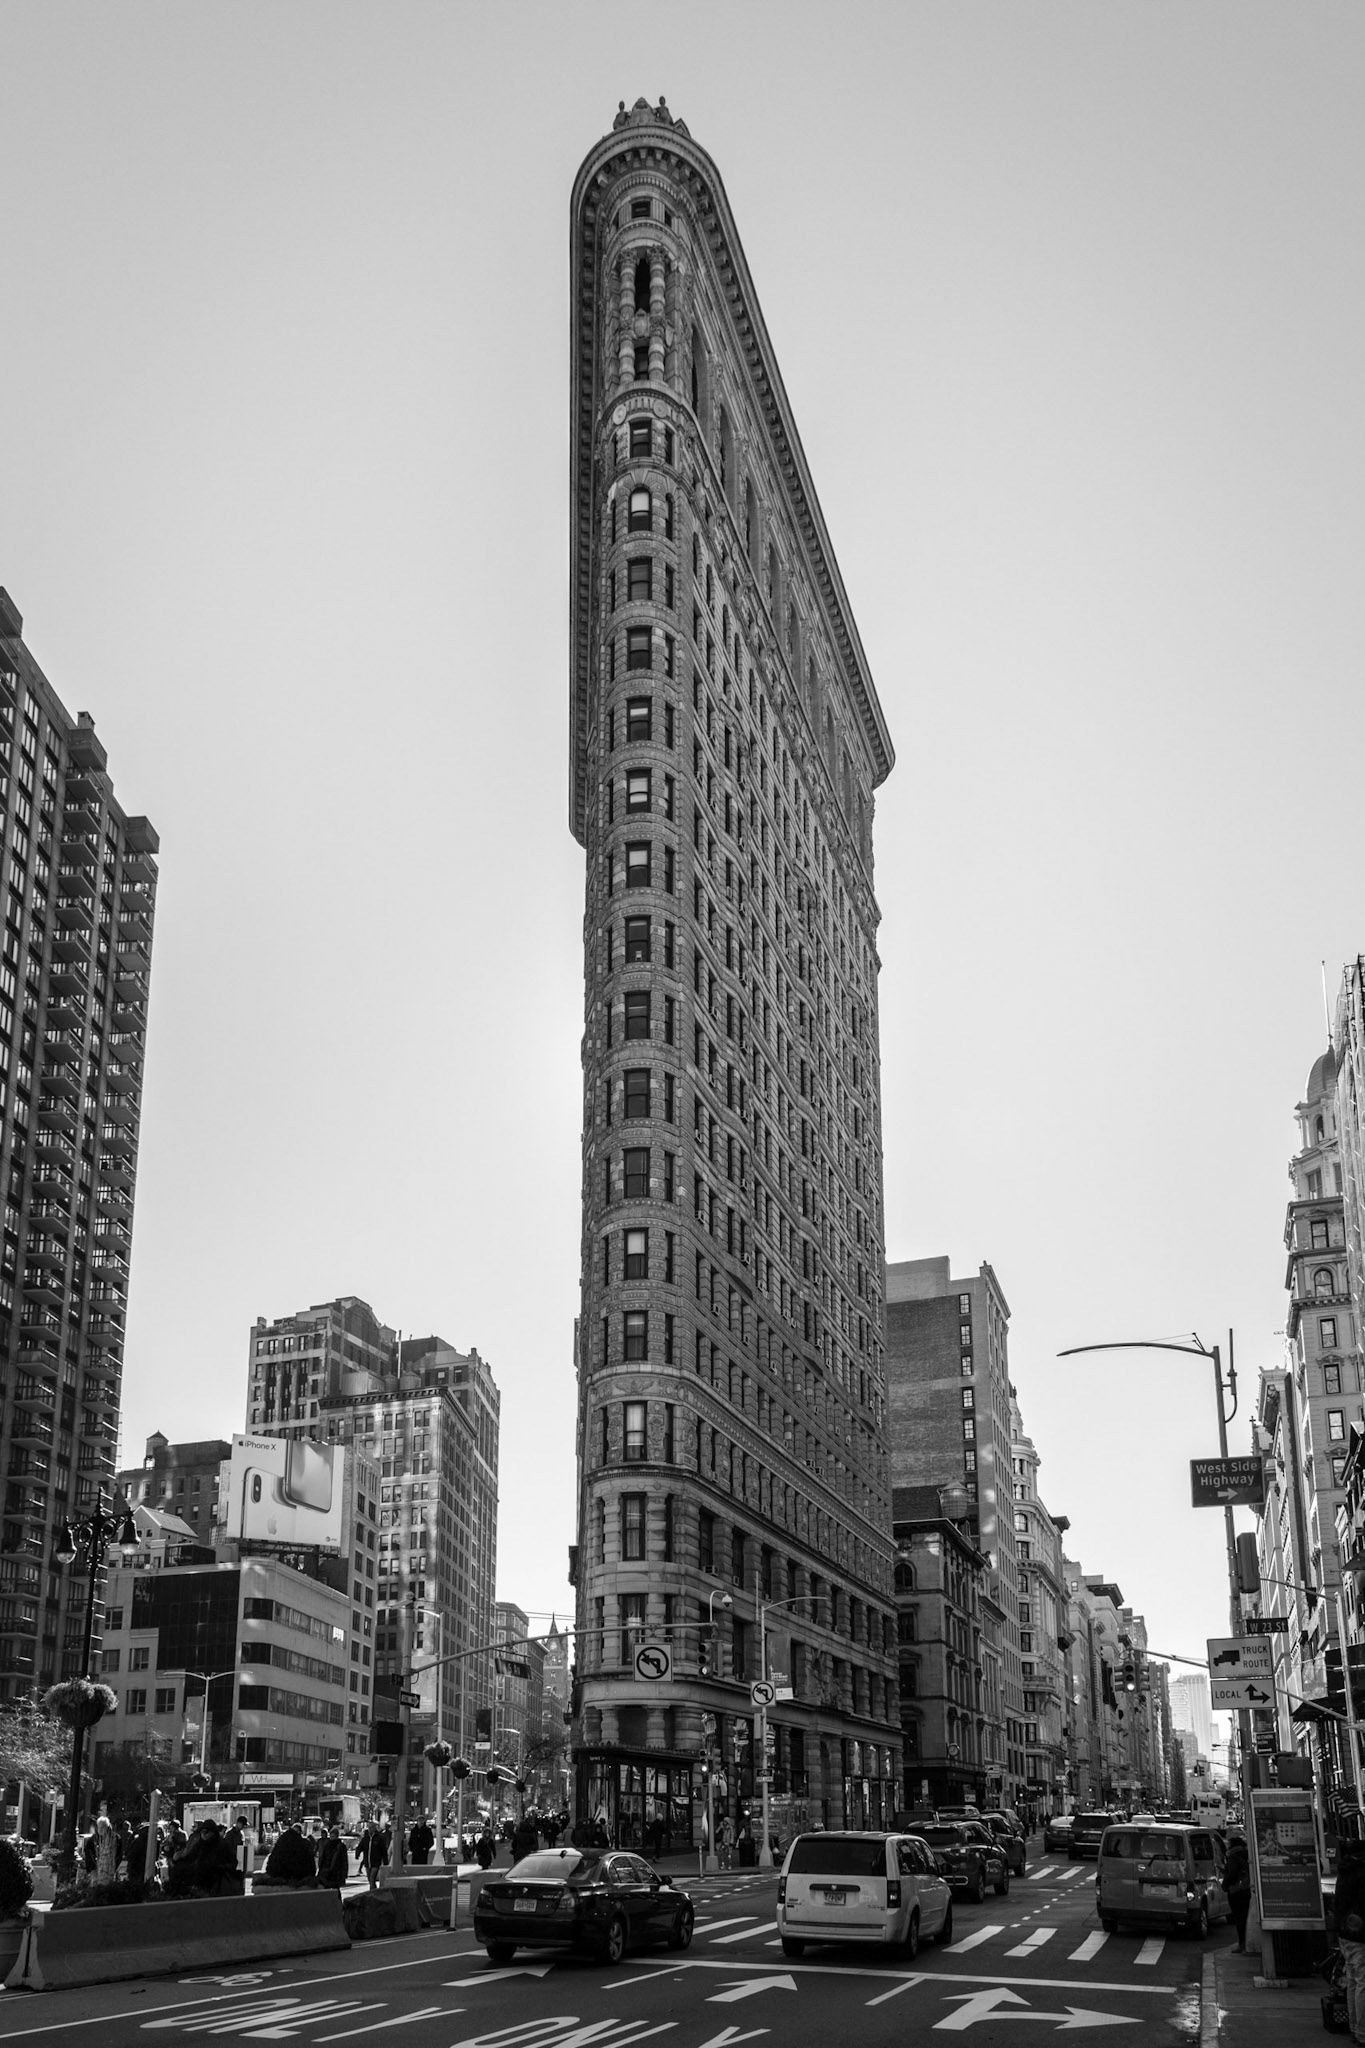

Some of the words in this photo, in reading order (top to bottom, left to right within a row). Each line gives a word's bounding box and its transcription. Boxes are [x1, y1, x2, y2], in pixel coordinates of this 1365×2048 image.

[244, 1440, 270, 1450] iPhone
[270, 1443, 277, 1451] X
[1195, 1463, 1227, 1474] West
[1231, 1461, 1258, 1472] Side
[1200, 1475, 1255, 1488] Highway
[1250, 1623, 1258, 1632] W
[1262, 1622, 1273, 1632] 23
[1276, 1621, 1285, 1631] St
[1241, 1645, 1268, 1654] TRUCK
[1243, 1659, 1269, 1668] ROUTE
[1215, 1691, 1242, 1699] LOCAL
[139, 1997, 468, 2043] ONLY
